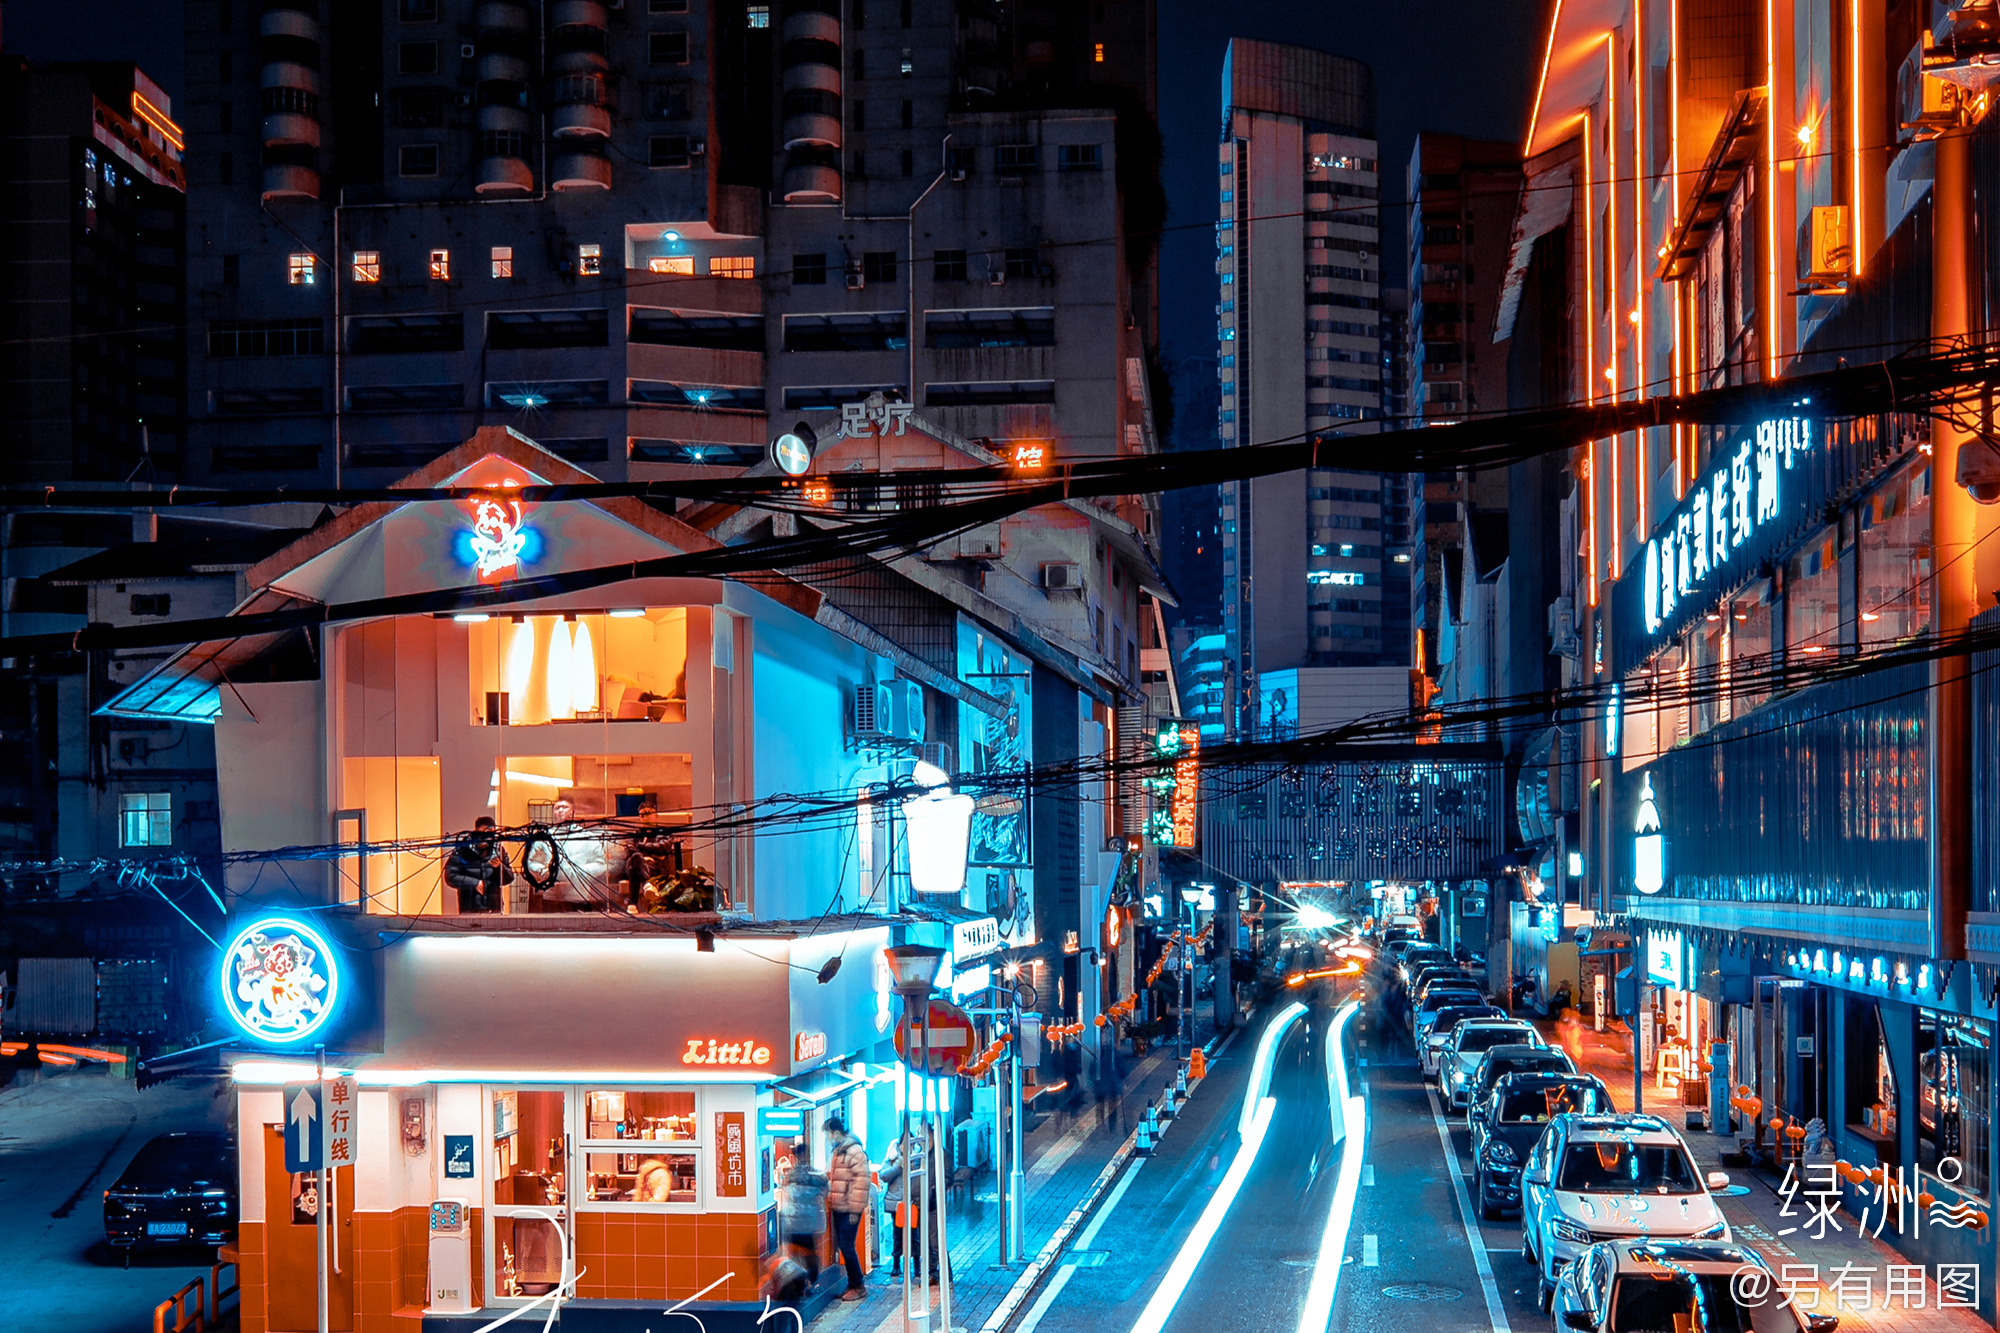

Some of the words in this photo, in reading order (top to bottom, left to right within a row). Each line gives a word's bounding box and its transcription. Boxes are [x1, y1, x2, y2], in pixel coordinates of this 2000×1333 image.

[837, 399, 914, 439] 足疗
[682, 1039, 771, 1065] Little
[795, 1031, 825, 1062] Seven
[331, 1081, 350, 1161] 单行线
